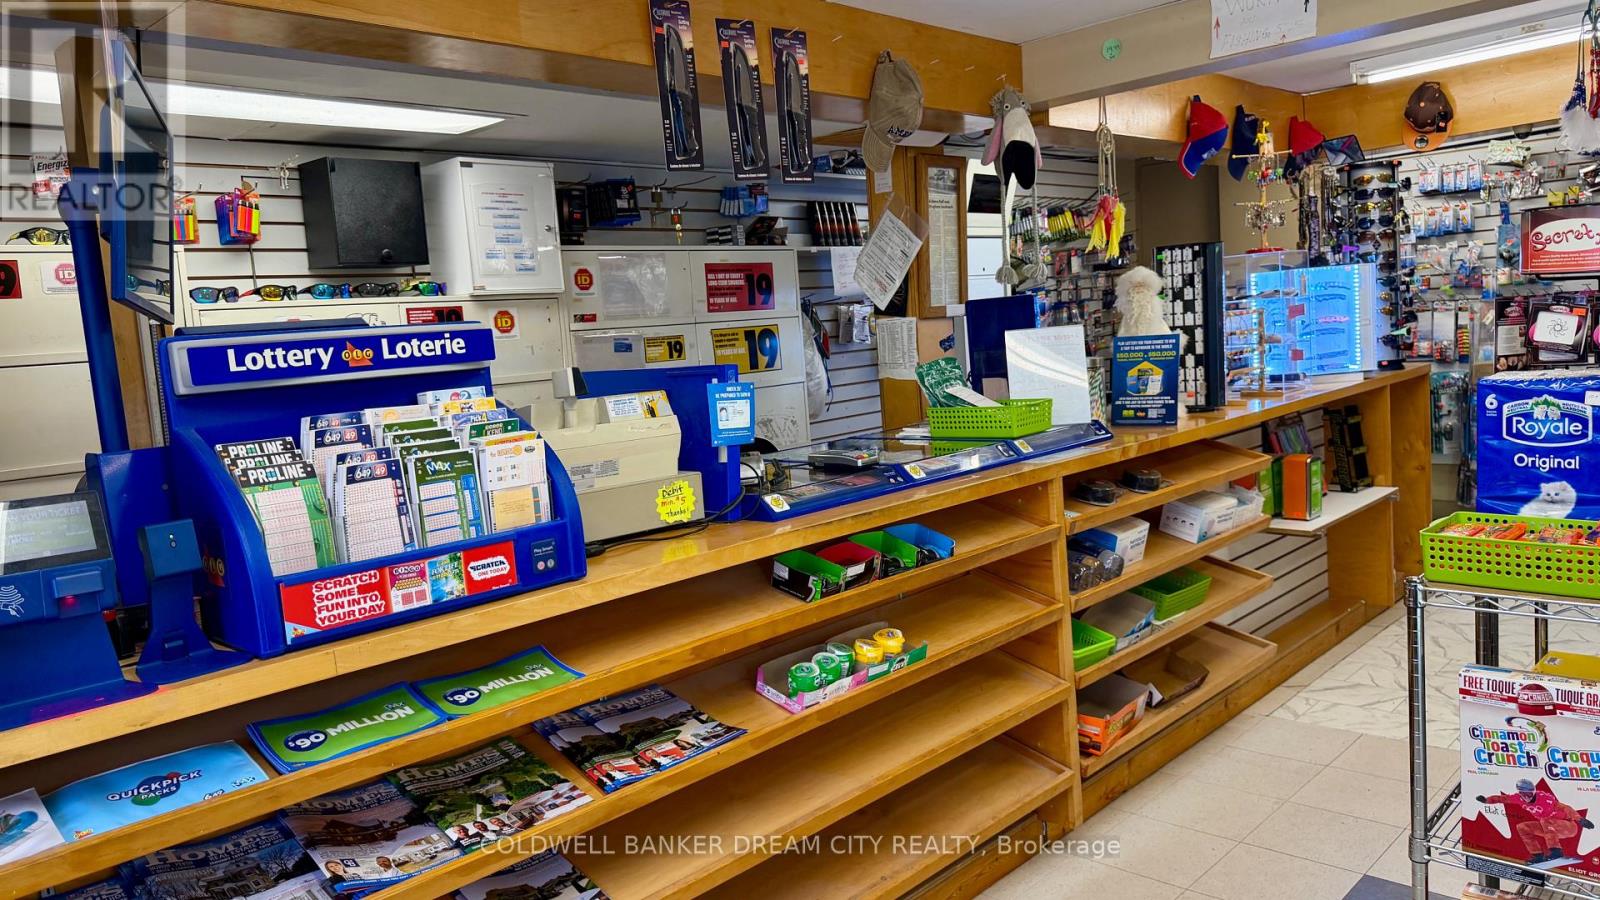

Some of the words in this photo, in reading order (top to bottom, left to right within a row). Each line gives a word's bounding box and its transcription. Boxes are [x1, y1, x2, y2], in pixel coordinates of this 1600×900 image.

[36, 160, 68, 171] Energiz
[745, 272, 772, 305] 19
[227, 346, 334, 372] Lottery
[342, 347, 374, 362] OLG
[382, 334, 466, 360] Loterie
[667, 340, 683, 359] 19
[744, 328, 778, 370] 19
[1485, 393, 1498, 410] 6
[324, 431, 342, 444] 649
[344, 428, 358, 441] 49
[1512, 416, 1583, 440] Royale
[228, 440, 284, 459] PROLINE
[354, 465, 373, 481] 649
[374, 463, 388, 477] 49
[1513, 453, 1580, 472] Original
[248, 463, 306, 484] PROLINE
[662, 484, 684, 499] Debit
[470, 560, 506, 571] SCRATCH
[489, 566, 507, 575] TODAY
[314, 571, 379, 593] SCRATCH
[315, 587, 357, 604] SOME
[317, 600, 346, 615] FUN
[347, 593, 380, 610] INTO
[318, 610, 356, 626] YOUR
[357, 602, 385, 618] DAY
[447, 690, 480, 705] $90
[478, 667, 554, 693] MILLION
[1463, 674, 1484, 691] FREE
[1486, 679, 1517, 696] TOQUE
[1555, 688, 1584, 706] TUQUE
[1586, 693, 1600, 708] GR
[288, 731, 326, 749] $90
[325, 705, 416, 737] MILLION
[1471, 725, 1537, 742] Cinnamon
[1484, 739, 1526, 754] Toast
[397, 749, 500, 784] HOMES
[1476, 748, 1539, 767] Crunch
[1549, 747, 1600, 767] Croqu
[1547, 763, 1600, 779] Canne
[107, 769, 202, 801] QUICKPICK
[141, 785, 177, 800] PACKS
[146, 827, 280, 868] HOMES
[1568, 866, 1587, 877] ELIOT
